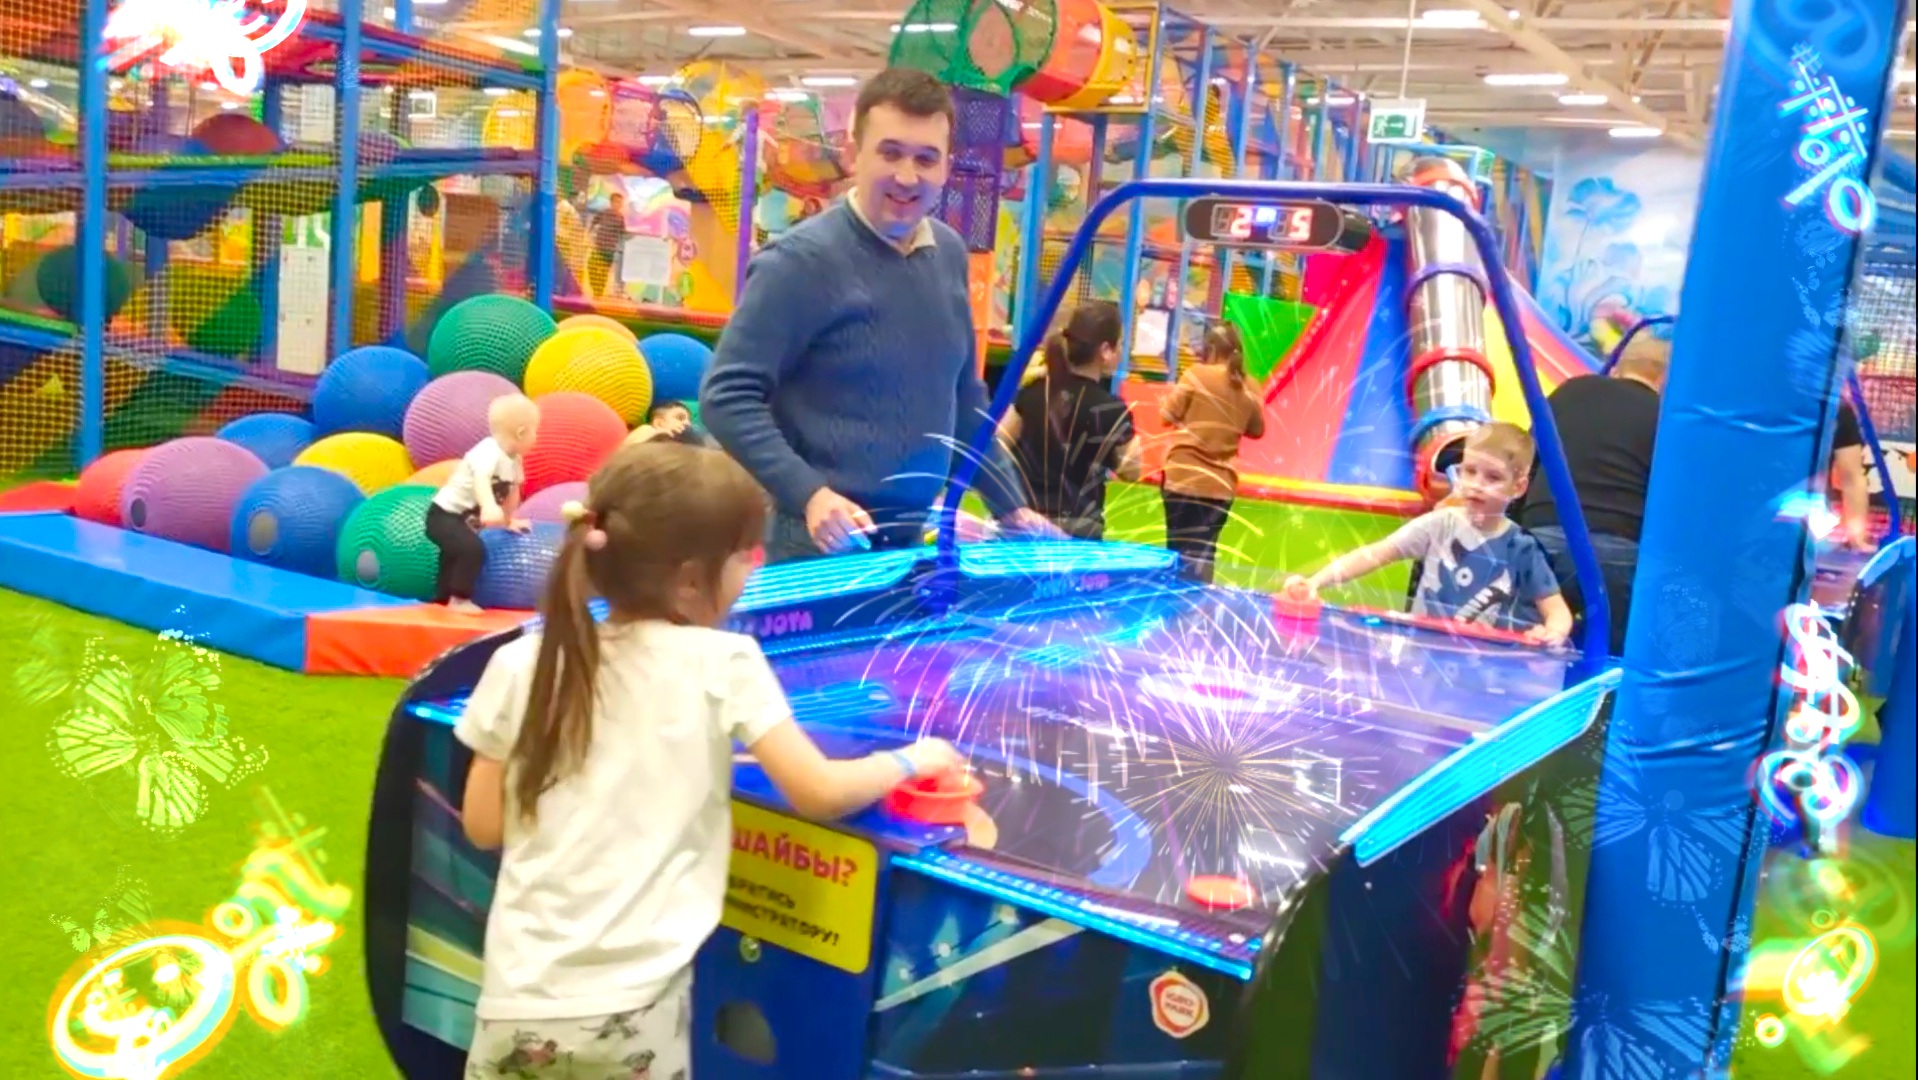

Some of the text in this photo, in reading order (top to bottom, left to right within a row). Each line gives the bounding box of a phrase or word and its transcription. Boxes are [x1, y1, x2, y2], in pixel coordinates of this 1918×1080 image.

[1230, 207, 1313, 241] 2 5
[760, 610, 813, 637] JOYA
